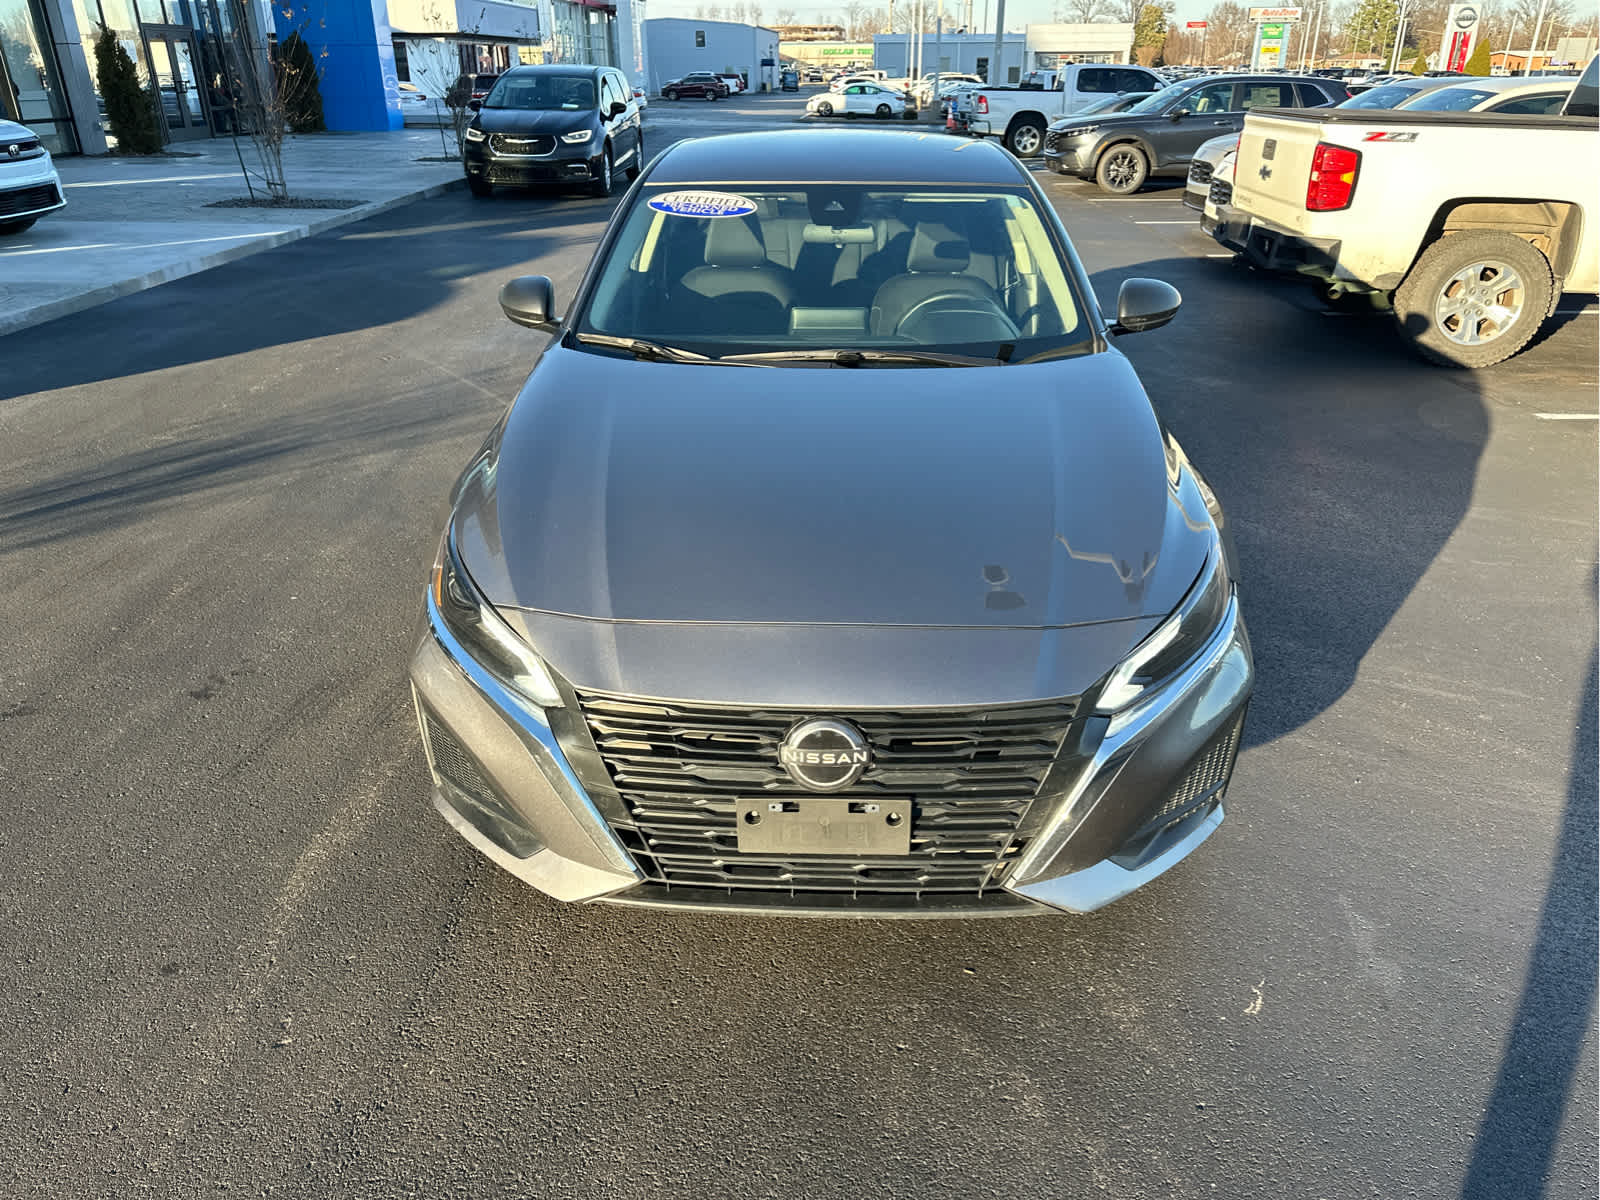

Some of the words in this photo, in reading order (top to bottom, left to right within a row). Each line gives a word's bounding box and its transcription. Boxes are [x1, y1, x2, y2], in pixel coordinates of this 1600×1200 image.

[1362, 131, 1419, 142] Z71
[664, 195, 746, 207] CERTIFIED
[673, 206, 724, 215] VEHICLE
[783, 751, 867, 764] NISSAN
